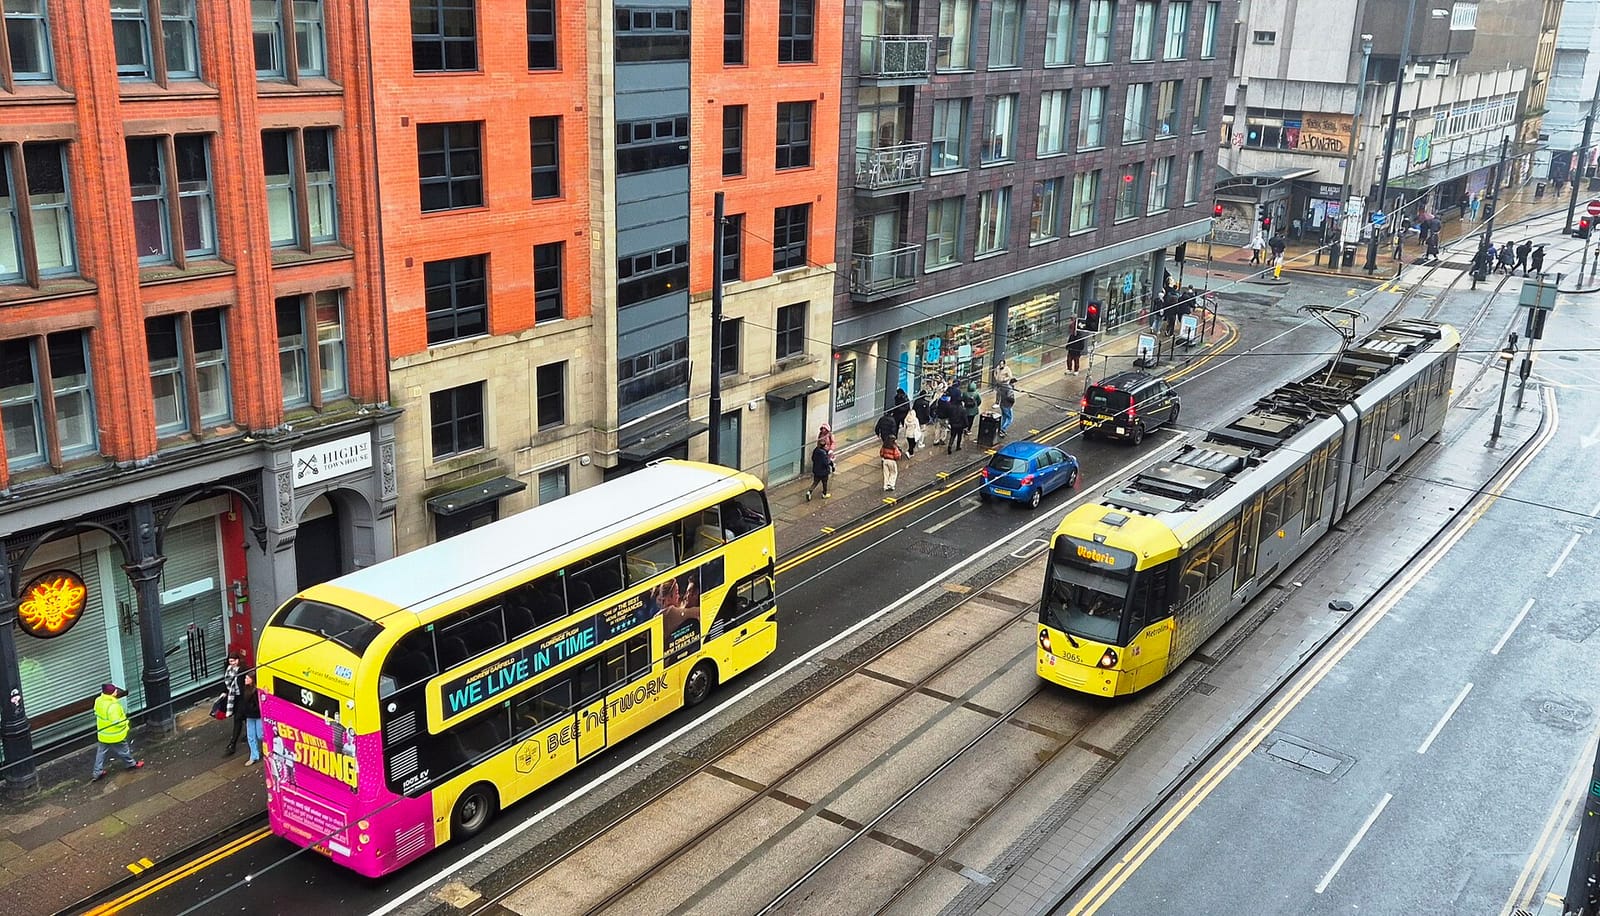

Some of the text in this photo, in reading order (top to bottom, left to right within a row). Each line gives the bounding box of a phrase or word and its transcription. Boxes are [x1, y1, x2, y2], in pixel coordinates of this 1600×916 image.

[323, 445, 358, 464] HIGH
[324, 453, 368, 471] TOWNHOUSE
[1077, 545, 1115, 566] Victoria
[617, 601, 643, 618] ROMANCES
[618, 601, 628, 612] THE
[628, 596, 640, 607] BEST
[540, 627, 580, 650] FLORENCE PUGH
[335, 665, 352, 680] NHS
[448, 627, 594, 712] WE LIVE IN TIME
[466, 657, 515, 685] ANDREW GARFIELD
[301, 688, 314, 707] 59
[277, 721, 300, 742] GET
[300, 731, 328, 750] WINTER
[547, 719, 582, 754] BEE
[294, 741, 358, 789] STRONG
[403, 769, 430, 788] 100% EV
